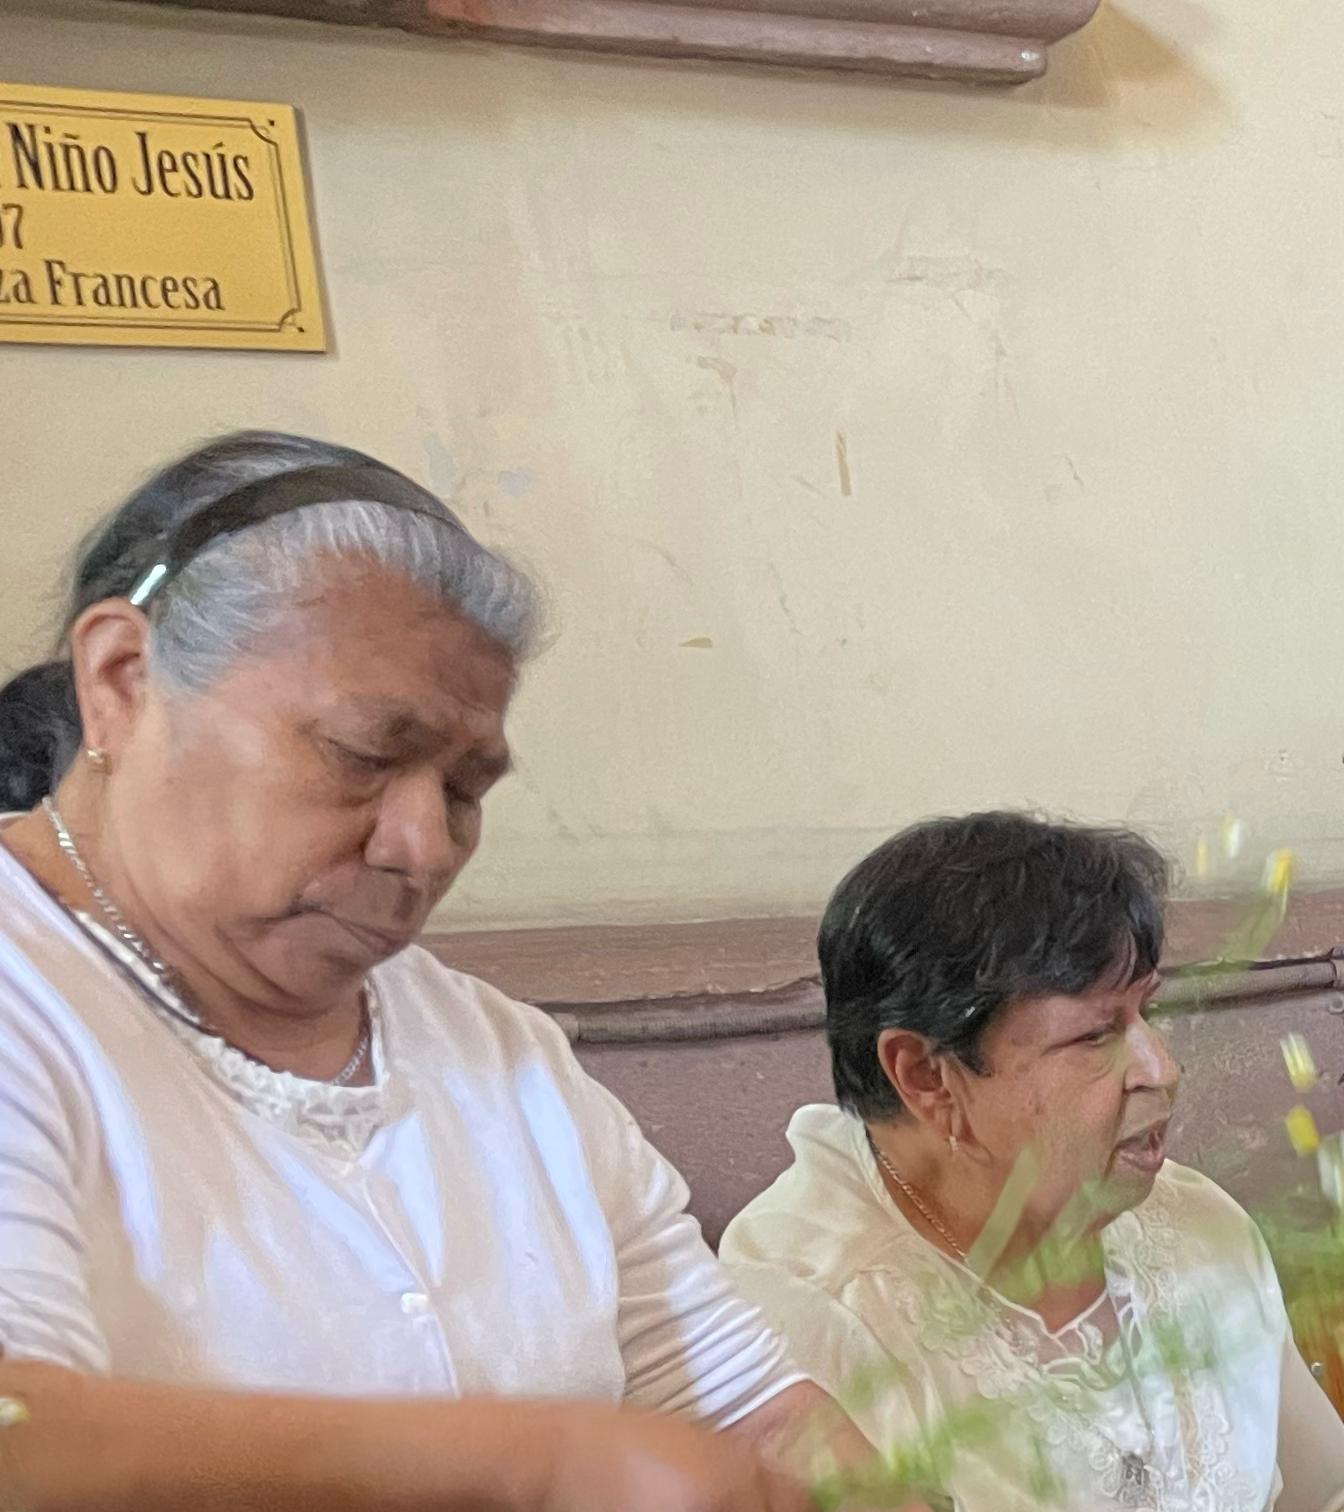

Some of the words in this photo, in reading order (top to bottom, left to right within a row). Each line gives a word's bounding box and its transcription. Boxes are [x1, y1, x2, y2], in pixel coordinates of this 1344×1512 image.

[7, 121, 118, 194] Niño
[131, 131, 255, 202] Jesús
[44, 258, 226, 312] Francesa
